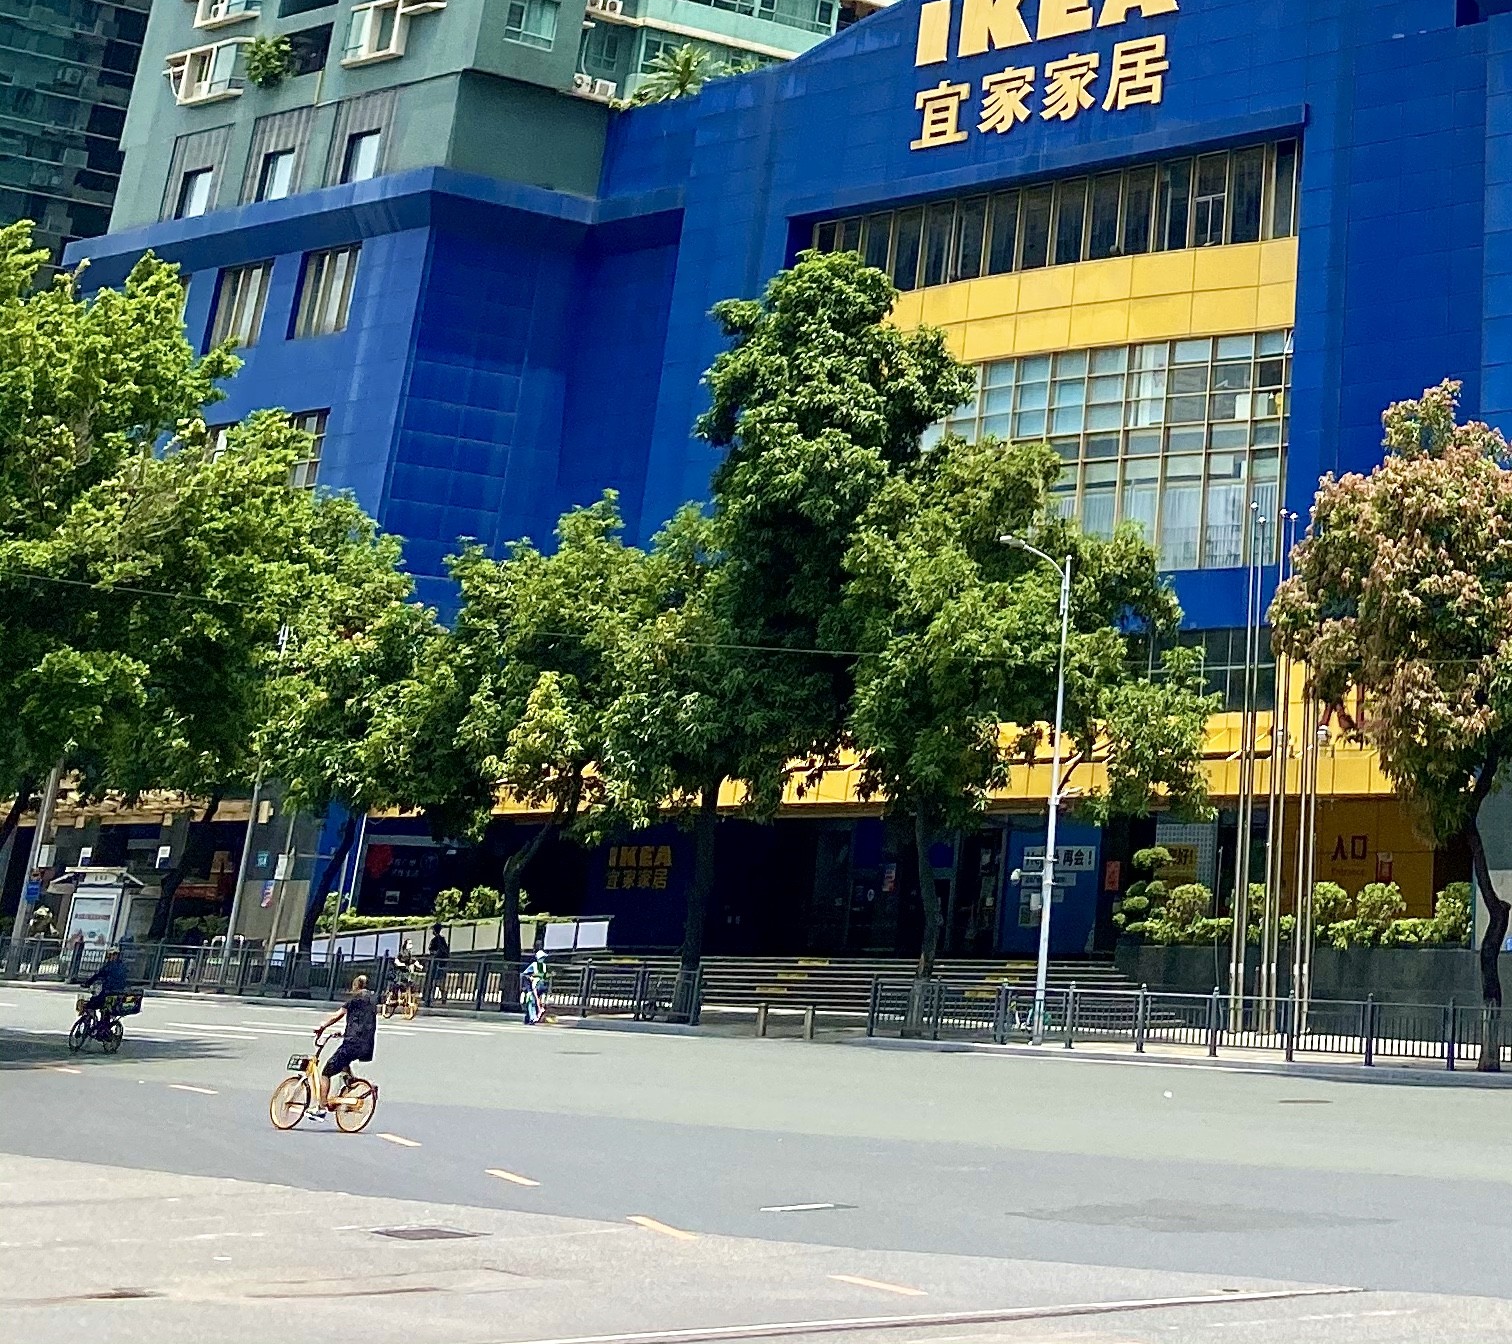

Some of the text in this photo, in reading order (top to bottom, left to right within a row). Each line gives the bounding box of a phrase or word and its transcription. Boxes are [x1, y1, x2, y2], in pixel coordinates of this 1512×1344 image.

[909, 34, 1170, 151] 宜家家居
[608, 845, 673, 867] IKEA
[1331, 834, 1368, 861] 入口
[605, 868, 668, 890] 宜家家居
